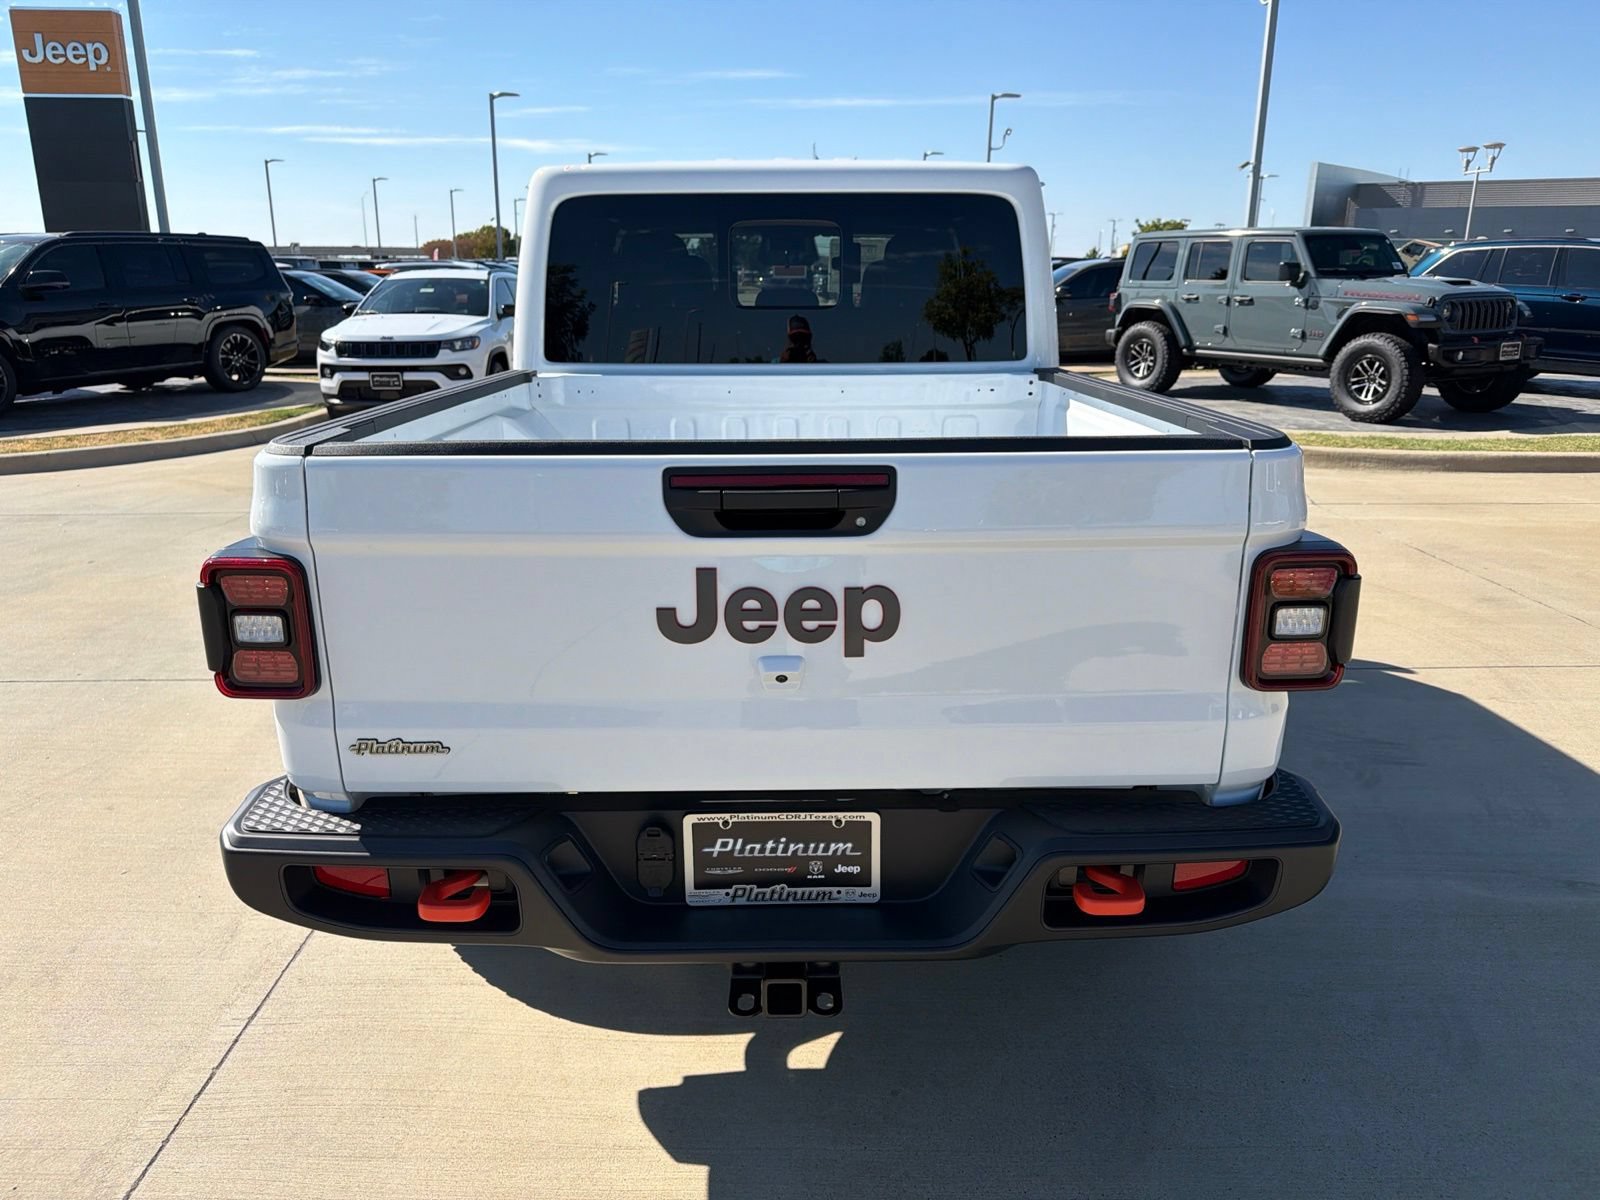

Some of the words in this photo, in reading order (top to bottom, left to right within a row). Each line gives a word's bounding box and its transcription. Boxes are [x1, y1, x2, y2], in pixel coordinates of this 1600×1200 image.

[22, 32, 110, 71] Jeep
[656, 567, 901, 658] Jeep
[349, 738, 450, 755] Platinum
[697, 813, 866, 822] www.PlatinumCDRJTexas.com
[702, 837, 862, 857] Platinum
[834, 863, 861, 874] Jeep
[731, 886, 841, 903] Platinum
